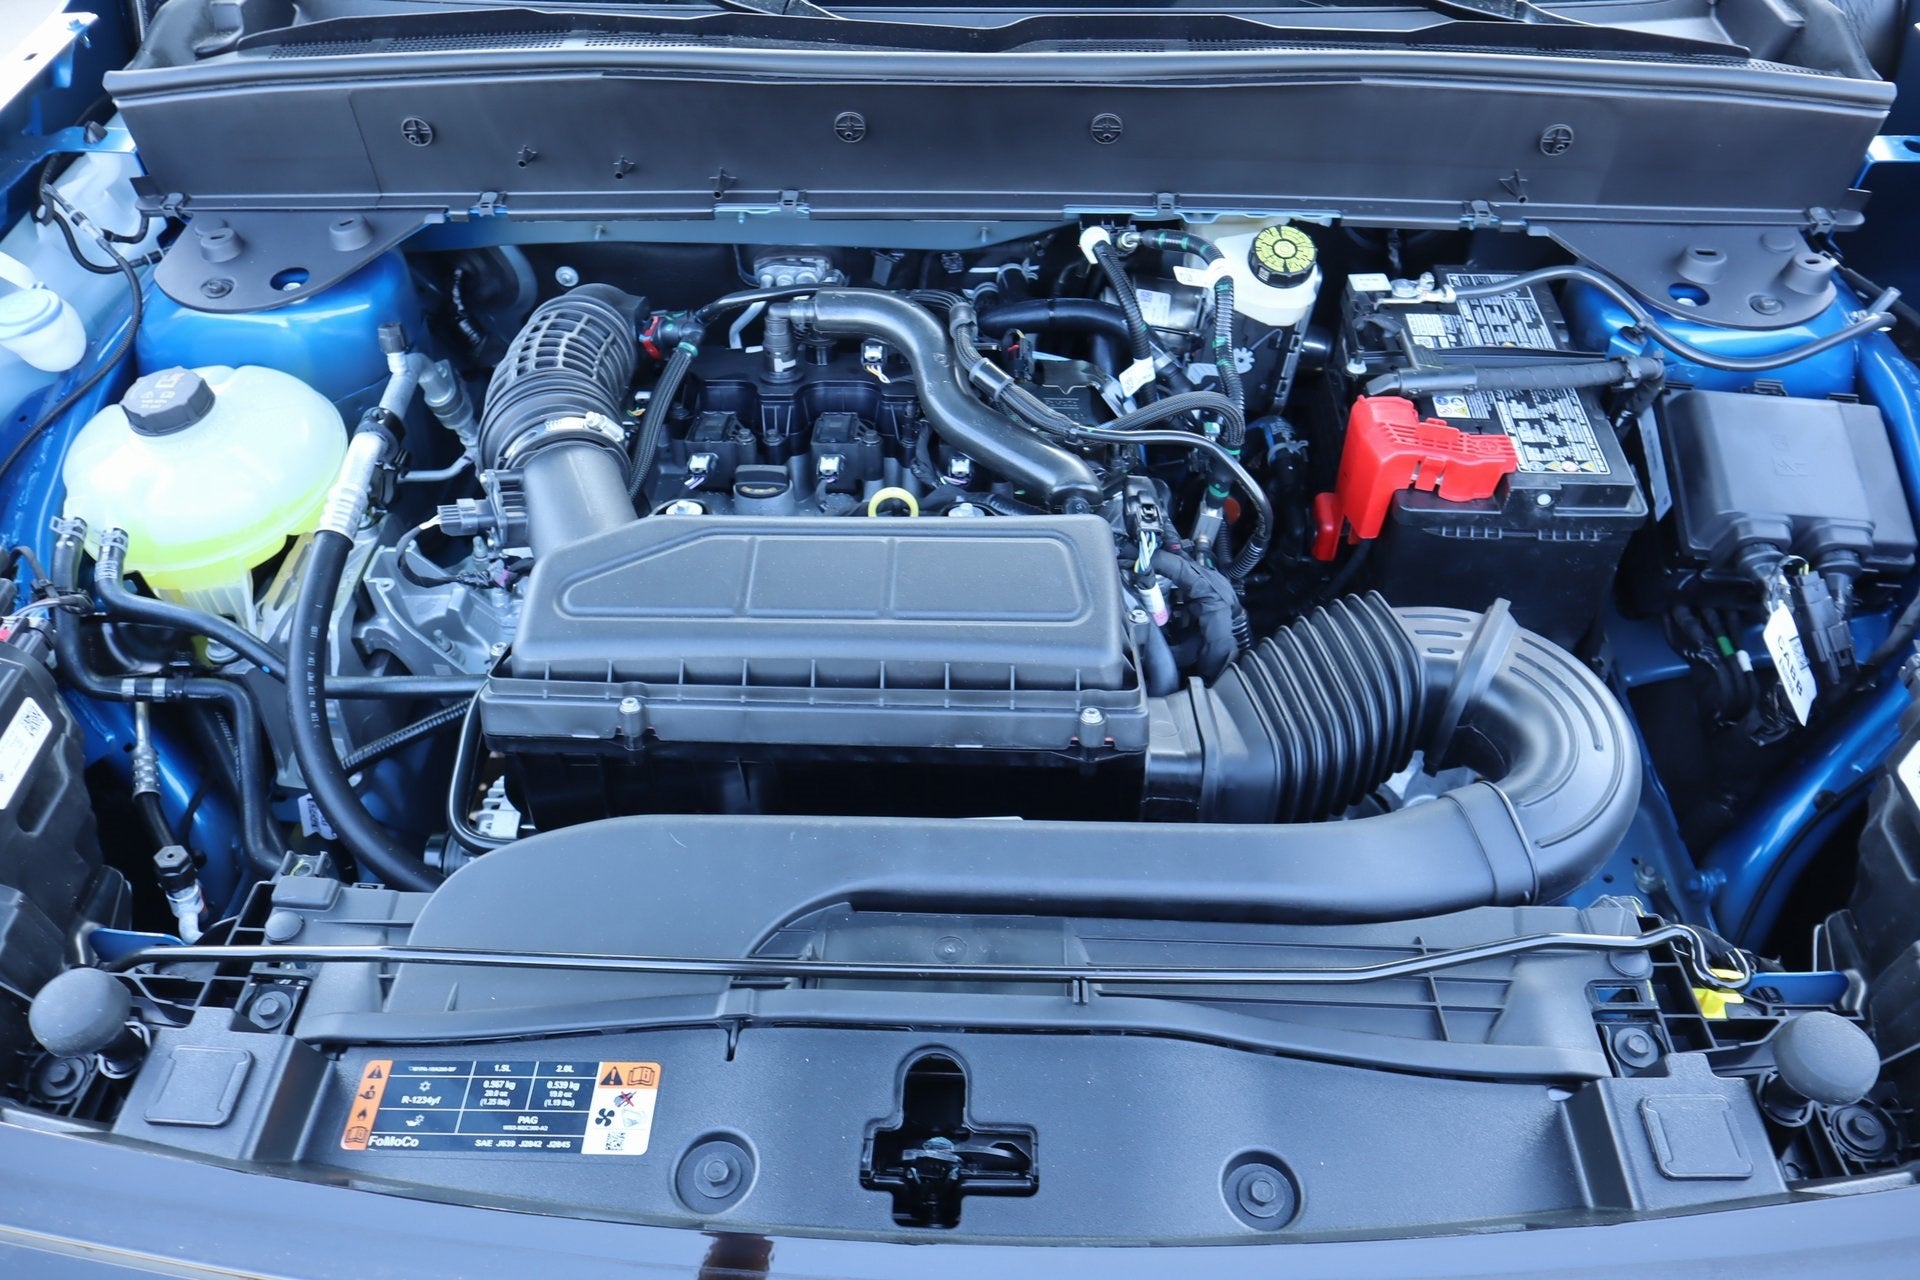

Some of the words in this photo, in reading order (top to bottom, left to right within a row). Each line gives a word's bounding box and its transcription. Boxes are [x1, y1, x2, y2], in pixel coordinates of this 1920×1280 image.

[494, 1064, 511, 1072] 1.5L
[555, 1065, 574, 1073] 2.0L
[505, 1080, 516, 1091] kg
[569, 1081, 580, 1091] kg
[401, 1096, 442, 1106] R-1234yf
[517, 1116, 538, 1124] PAG
[367, 1136, 420, 1147] FoMoCo
[475, 1139, 493, 1147] SAE
